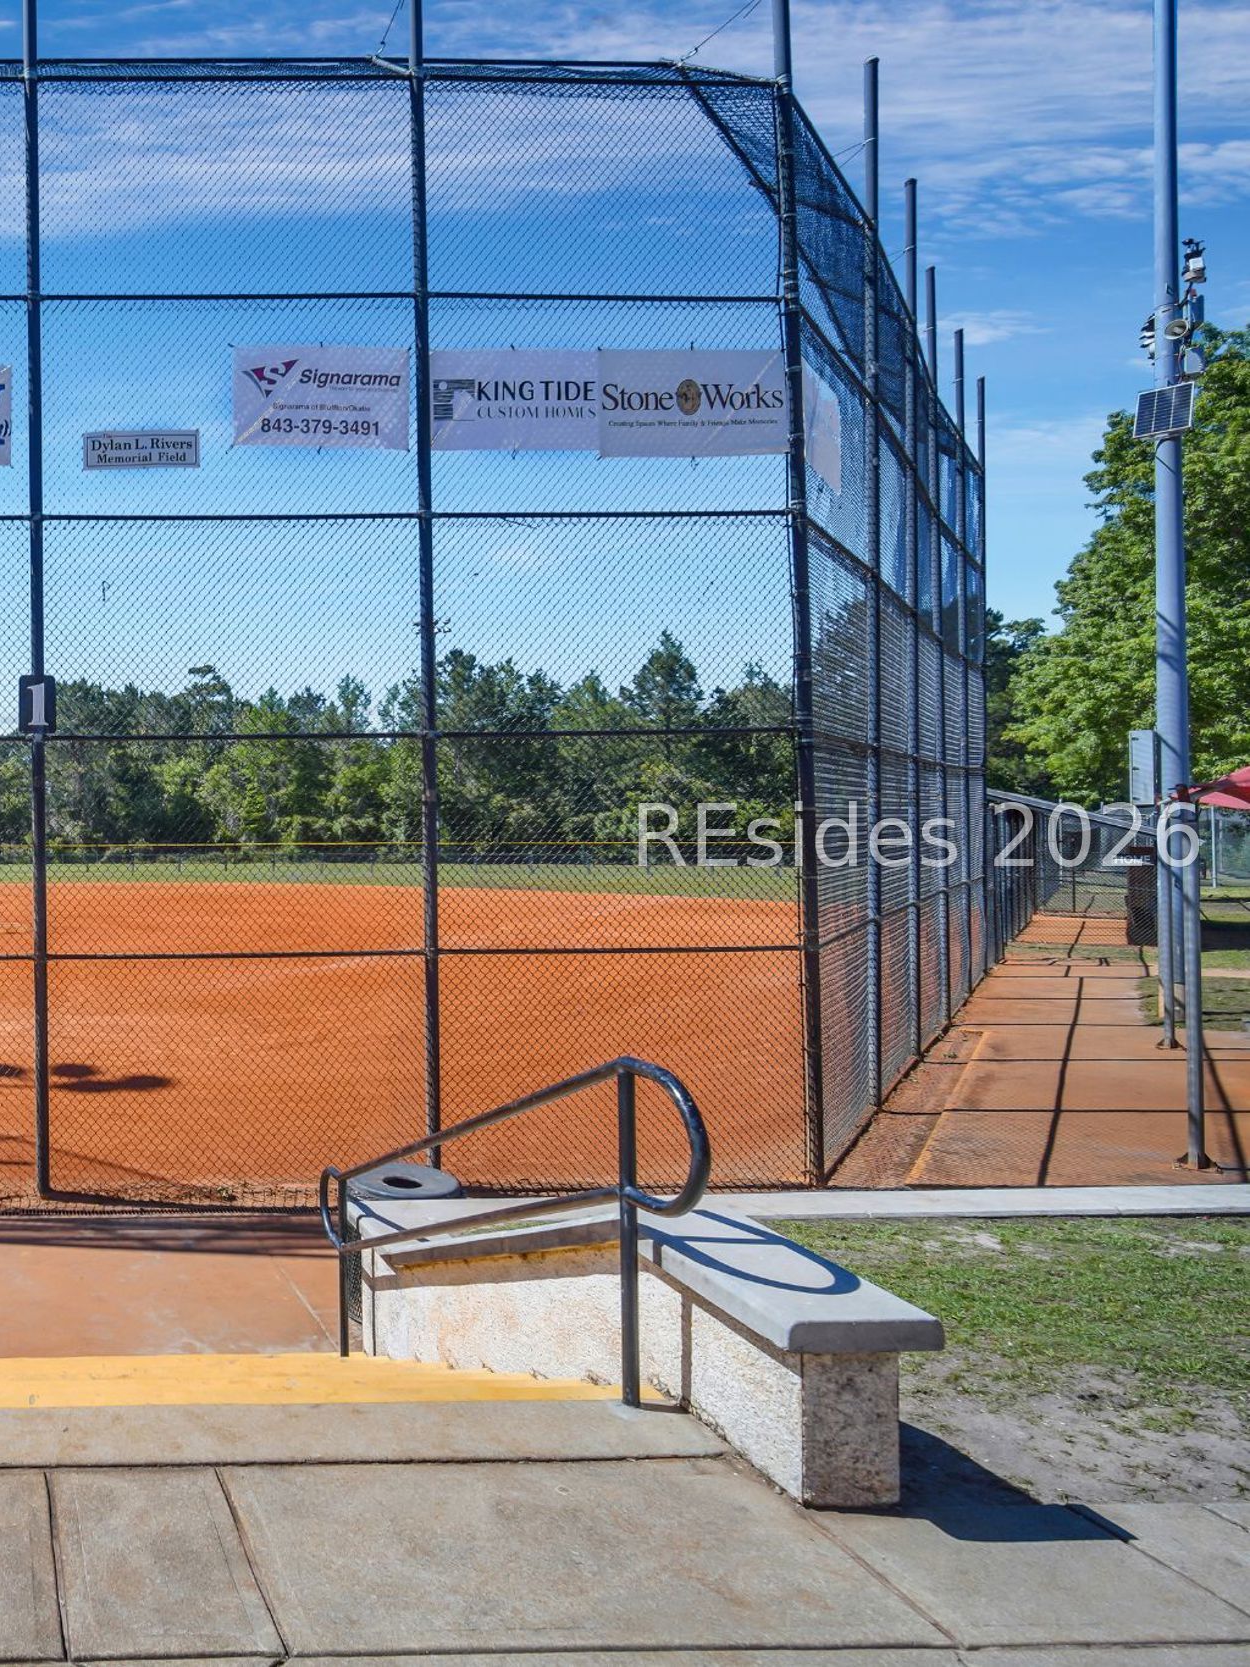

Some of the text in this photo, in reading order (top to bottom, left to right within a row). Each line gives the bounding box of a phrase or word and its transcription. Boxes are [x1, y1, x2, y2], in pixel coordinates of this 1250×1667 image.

[299, 368, 401, 388] Signarama
[477, 381, 596, 401] KING TIDE
[601, 383, 784, 411] Stone Works
[477, 405, 597, 419] CUSTOM HOMES
[261, 418, 380, 436] 843-379-3491
[91, 437, 193, 454] Dylan L. Rivers
[97, 452, 187, 464] Memorial Field
[27, 682, 49, 726] 1
